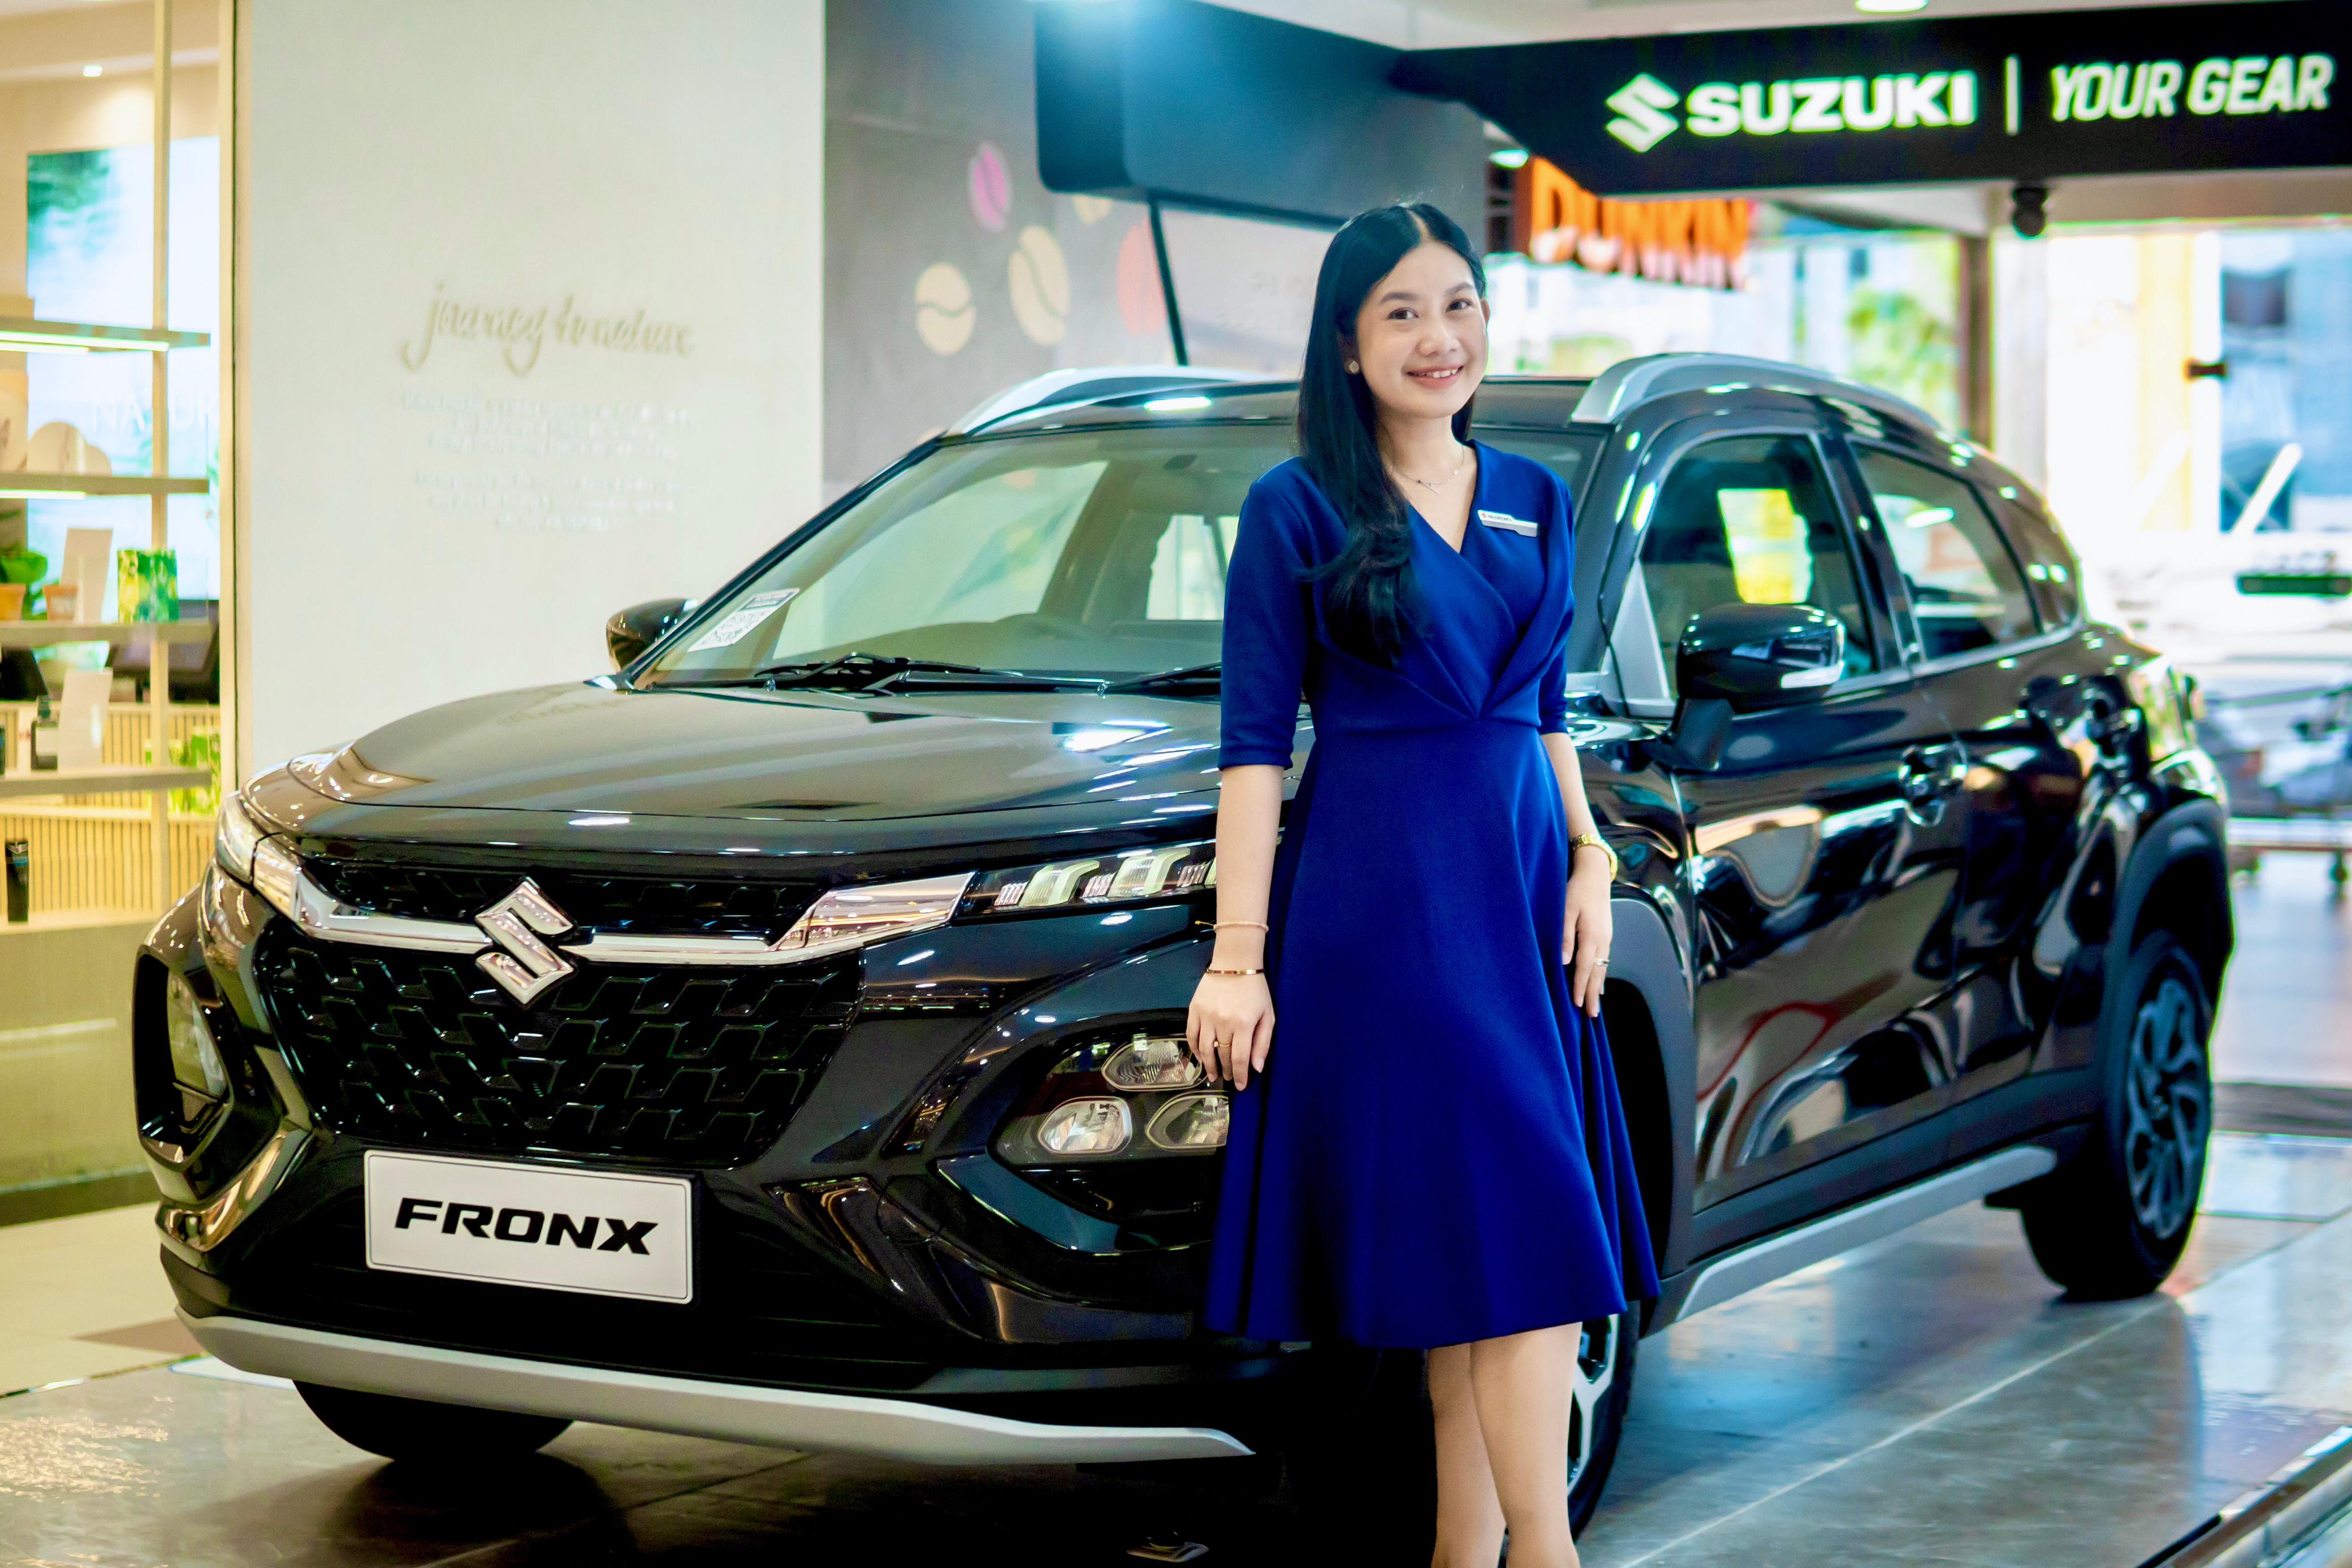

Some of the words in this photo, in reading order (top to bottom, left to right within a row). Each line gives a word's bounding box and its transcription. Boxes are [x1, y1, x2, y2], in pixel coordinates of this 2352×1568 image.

[1686, 70, 1978, 137] SUZUKI
[2051, 60, 2182, 123] YOUR
[2187, 53, 2334, 115] GEAR
[395, 1197, 659, 1255] FRONX
